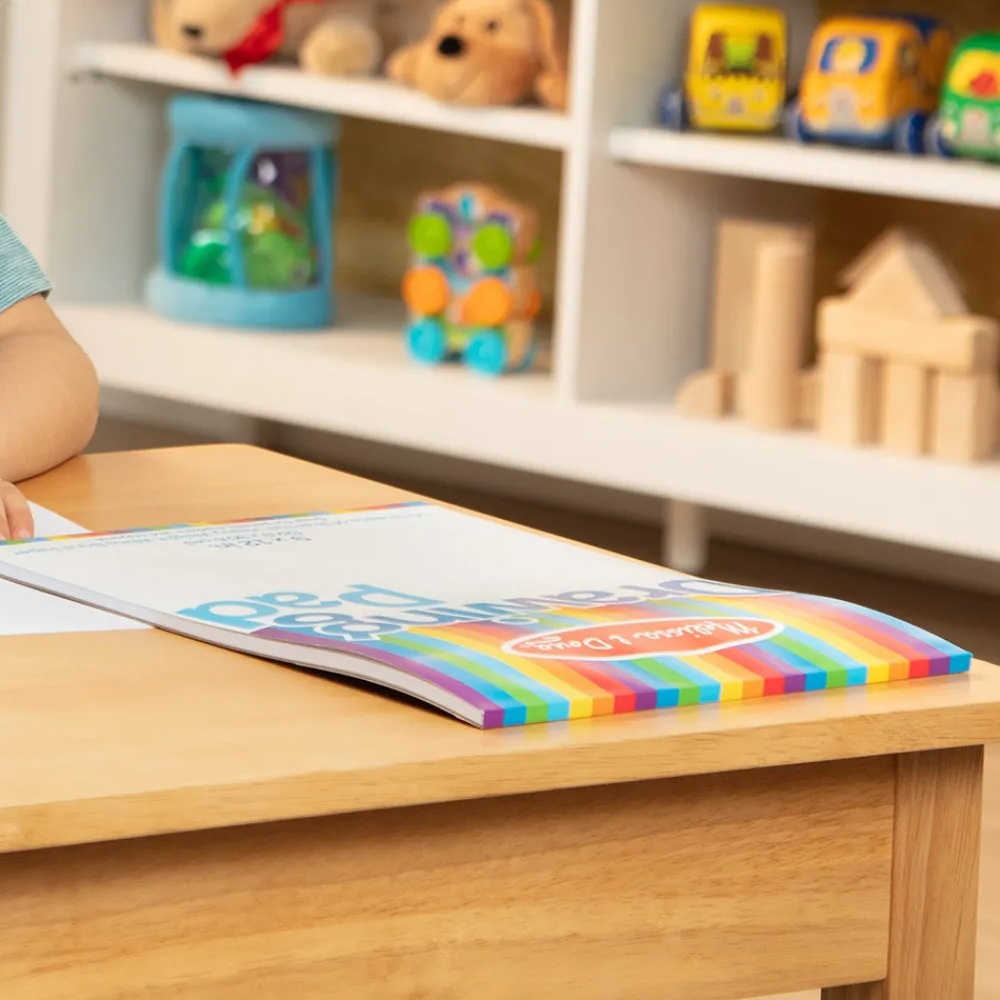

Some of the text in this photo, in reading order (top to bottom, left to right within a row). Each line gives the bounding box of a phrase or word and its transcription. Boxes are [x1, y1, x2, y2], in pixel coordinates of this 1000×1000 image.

[174, 583, 446, 629] Pad
[273, 579, 784, 642] Drawing
[526, 634, 613, 651] Doug
[633, 619, 760, 640] Melissa
